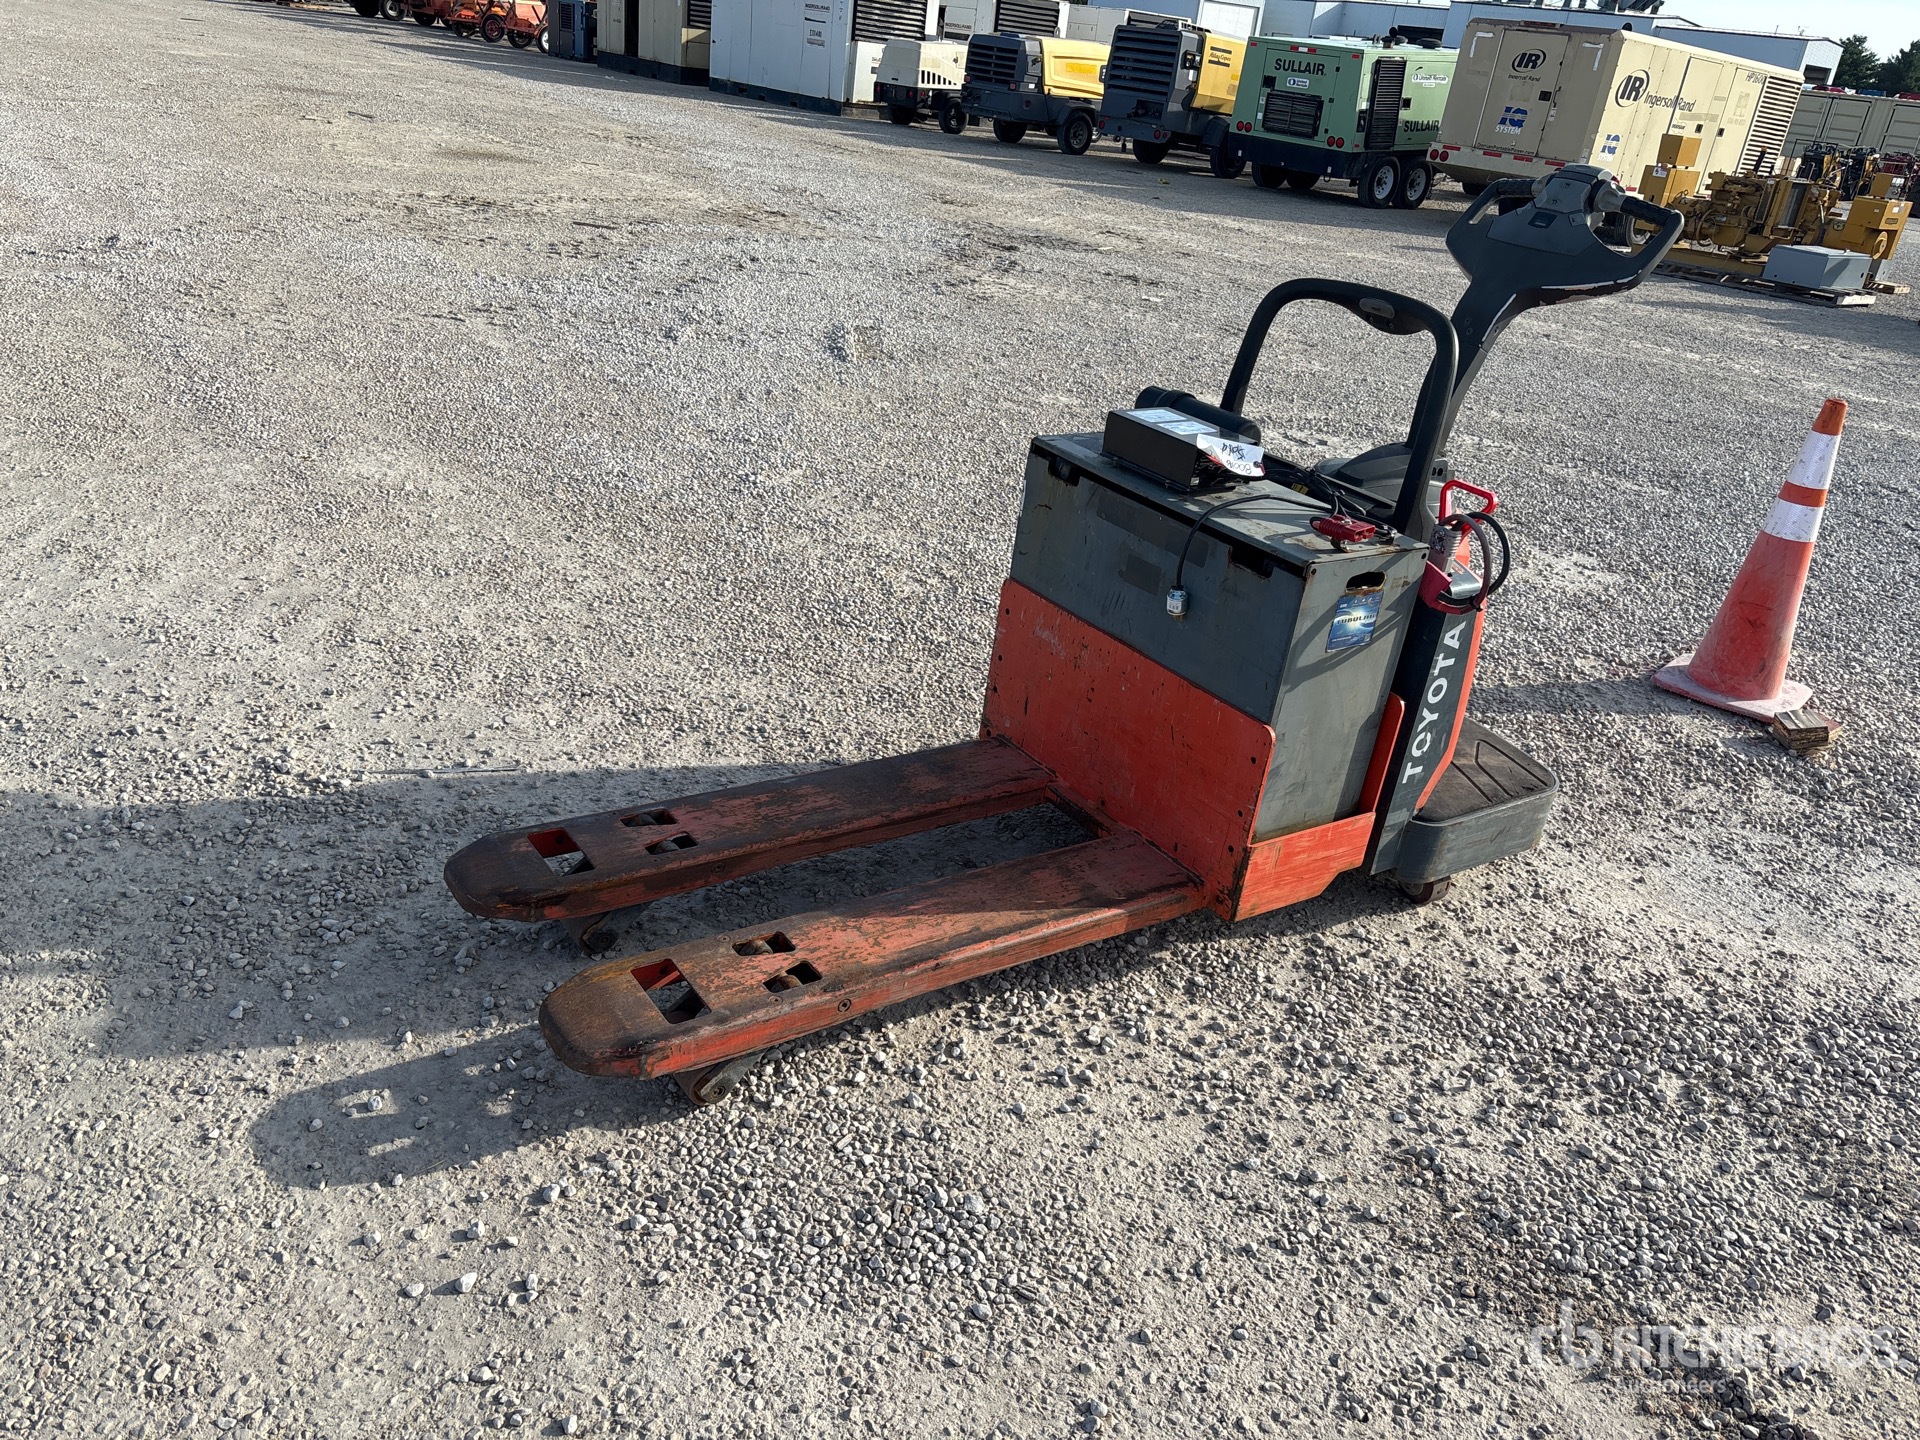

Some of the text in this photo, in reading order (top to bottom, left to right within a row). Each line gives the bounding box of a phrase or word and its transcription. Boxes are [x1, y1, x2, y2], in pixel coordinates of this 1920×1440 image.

[1274, 58, 1326, 76] SULLAIR
[1516, 52, 1541, 70] IR
[1619, 74, 1645, 102] IR
[1644, 91, 1697, 112] Ingersoll Rand
[1403, 120, 1440, 132] SULLAIR
[1495, 125, 1521, 135] SYSTEM
[1402, 621, 1467, 784] TOYOTA
